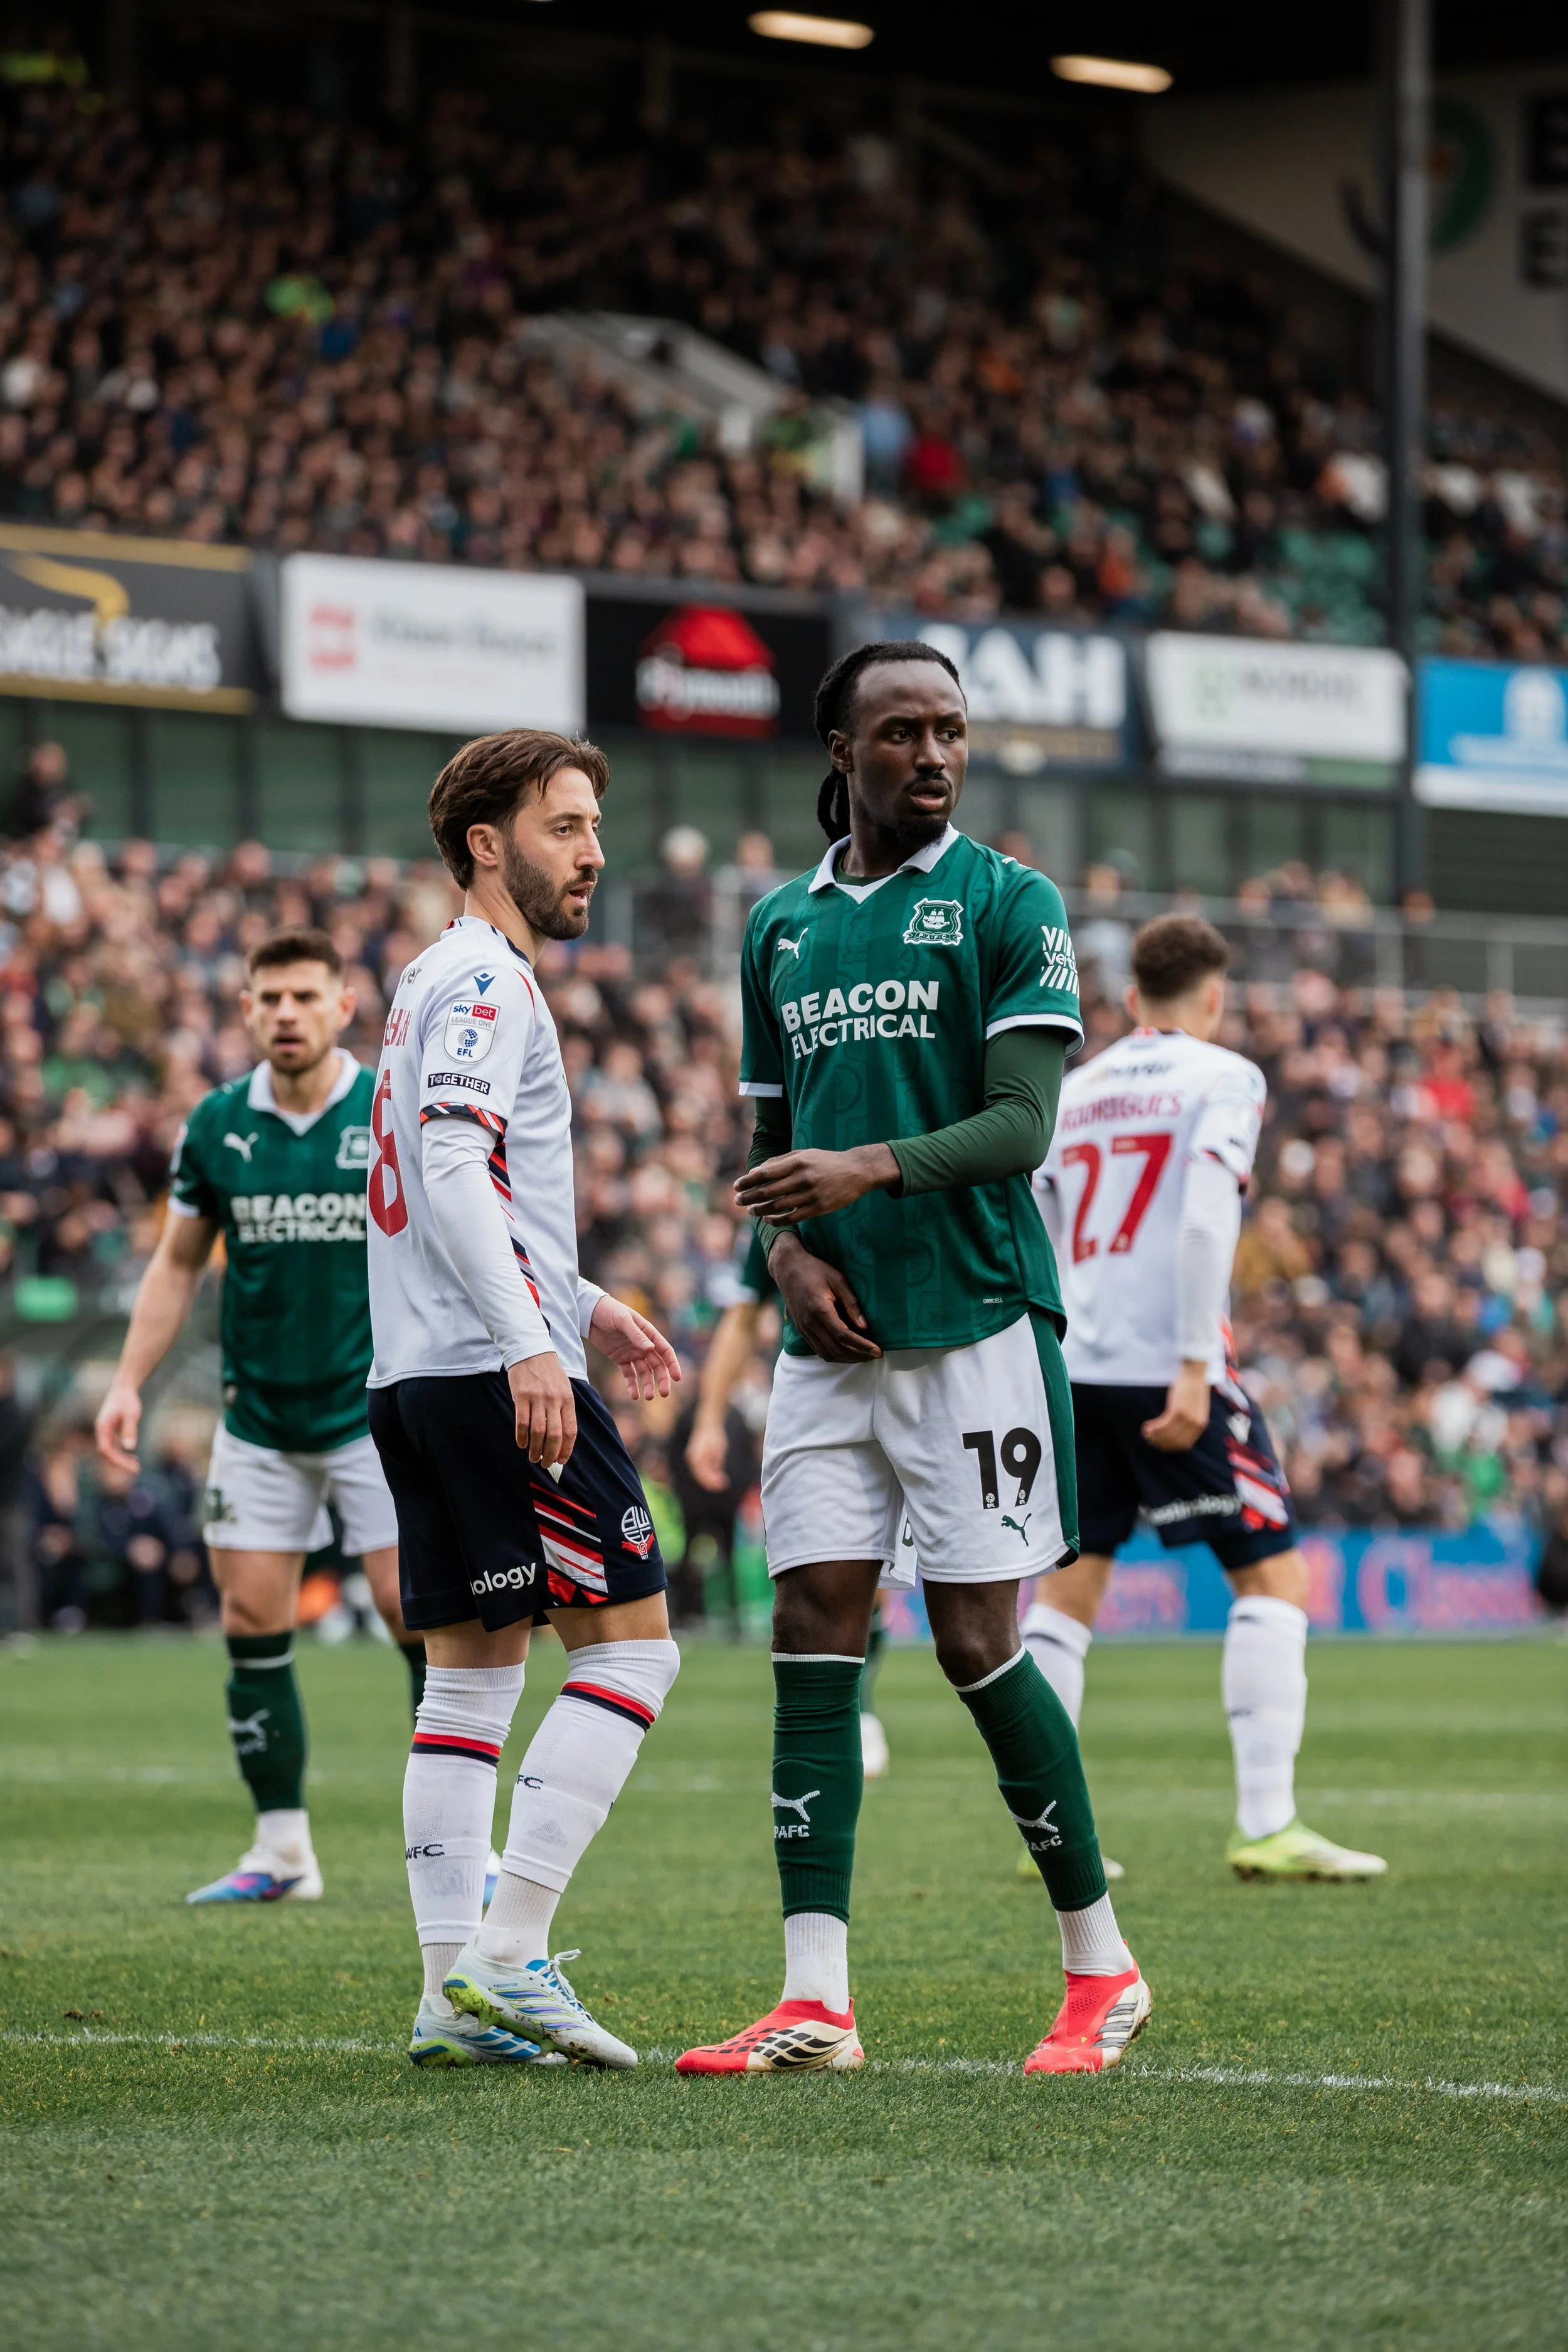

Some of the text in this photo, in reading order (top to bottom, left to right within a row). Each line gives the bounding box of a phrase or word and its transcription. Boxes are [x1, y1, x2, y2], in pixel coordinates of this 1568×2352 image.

[451, 1015, 493, 1029] LEAGUE ONE
[453, 1004, 494, 1018] sky bet
[781, 980, 940, 1034] BEACON
[457, 1047, 474, 1058] EFL
[791, 1014, 936, 1060] ELECTRICAL
[429, 1073, 489, 1094] TOGETHER
[230, 1192, 366, 1223] BEACON
[1062, 1134, 1172, 1264] 27
[961, 1427, 1042, 1510] 19
[470, 1562, 536, 1596] ology
[774, 1824, 810, 1838] PAFC
